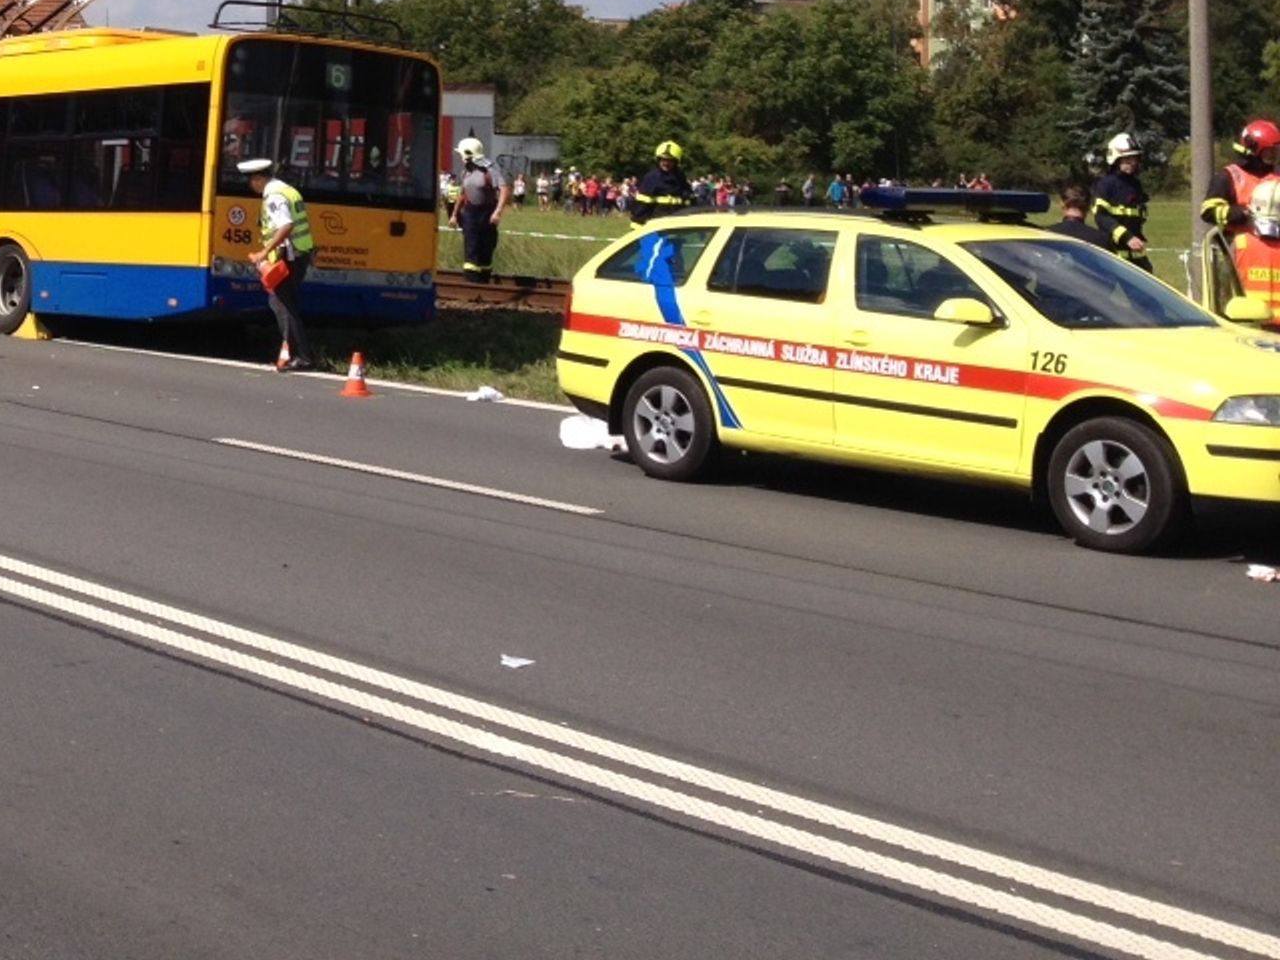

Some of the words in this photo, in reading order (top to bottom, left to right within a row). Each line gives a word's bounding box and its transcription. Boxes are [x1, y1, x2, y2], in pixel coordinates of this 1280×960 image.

[330, 65, 346, 88] 6
[222, 227, 252, 245] 458
[618, 321, 700, 348] ZDRAVOTNICKÁ
[703, 332, 776, 359] ZÁCHRANNÁ
[780, 344, 829, 366] SLUŽBA
[835, 350, 908, 377] ZLÍNSKÉHO
[913, 362, 960, 384] KRAJE
[1030, 350, 1068, 375] 126
